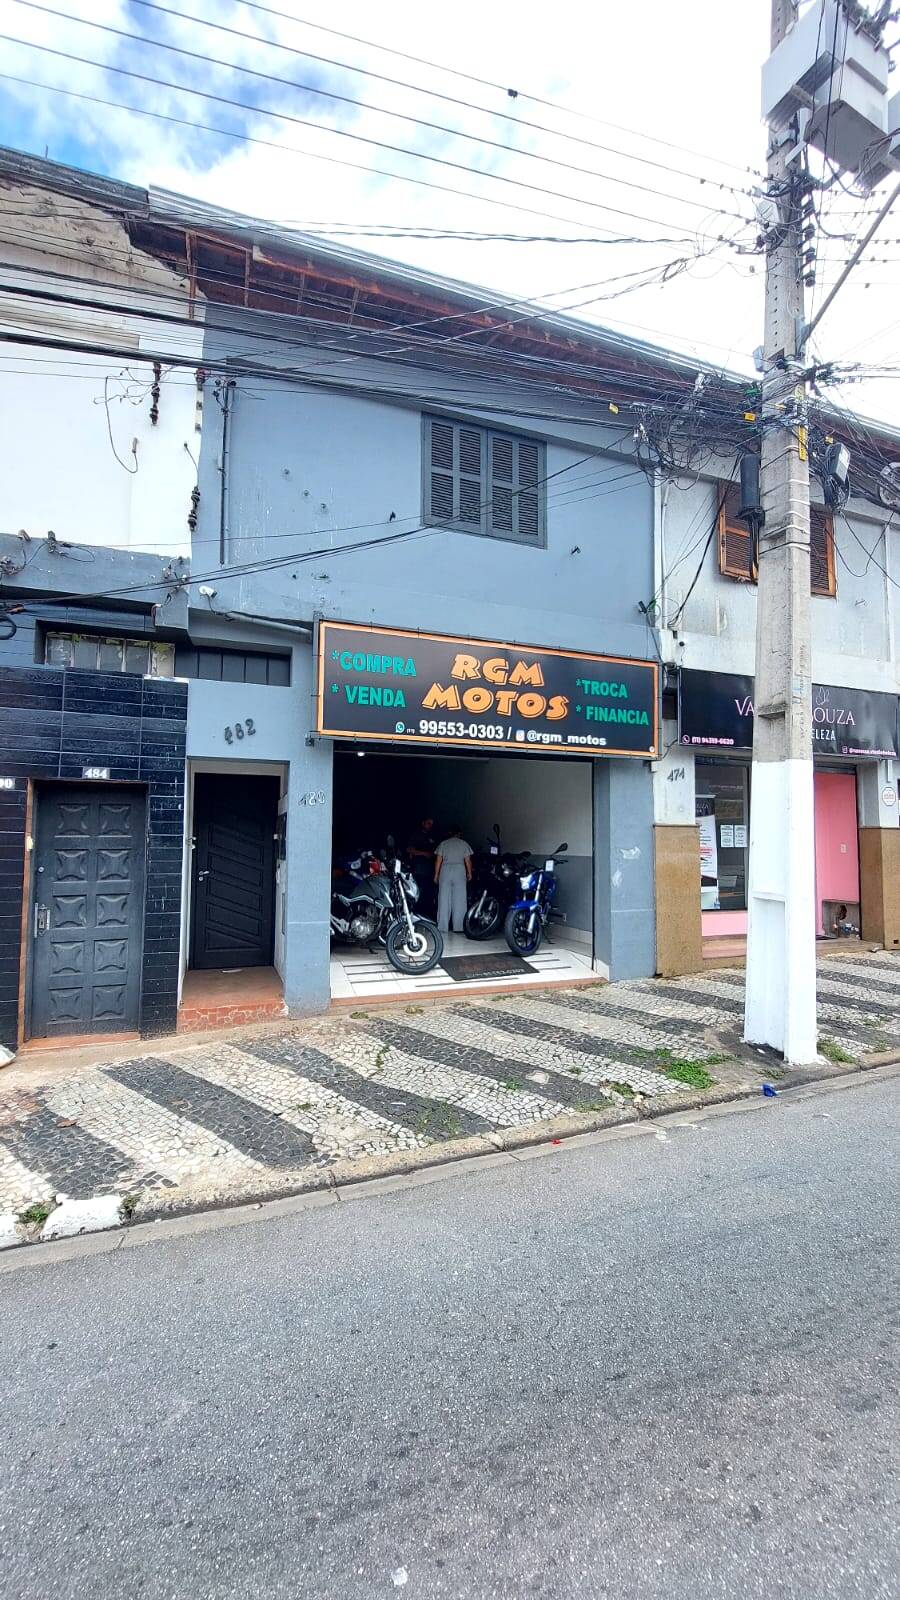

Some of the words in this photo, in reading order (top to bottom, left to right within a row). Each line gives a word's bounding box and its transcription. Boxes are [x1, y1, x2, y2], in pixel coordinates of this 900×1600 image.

[450, 653, 545, 687] RGM
[345, 684, 406, 708] VENDA
[421, 682, 569, 720] MOTOS
[586, 707, 649, 725] FINANCIA
[811, 706, 857, 726] OUZA
[224, 718, 257, 745] 482
[419, 720, 504, 740] 99553-0303
[527, 730, 607, 746] @rgm_motos
[84, 768, 107, 779] 484
[667, 767, 685, 782] 474
